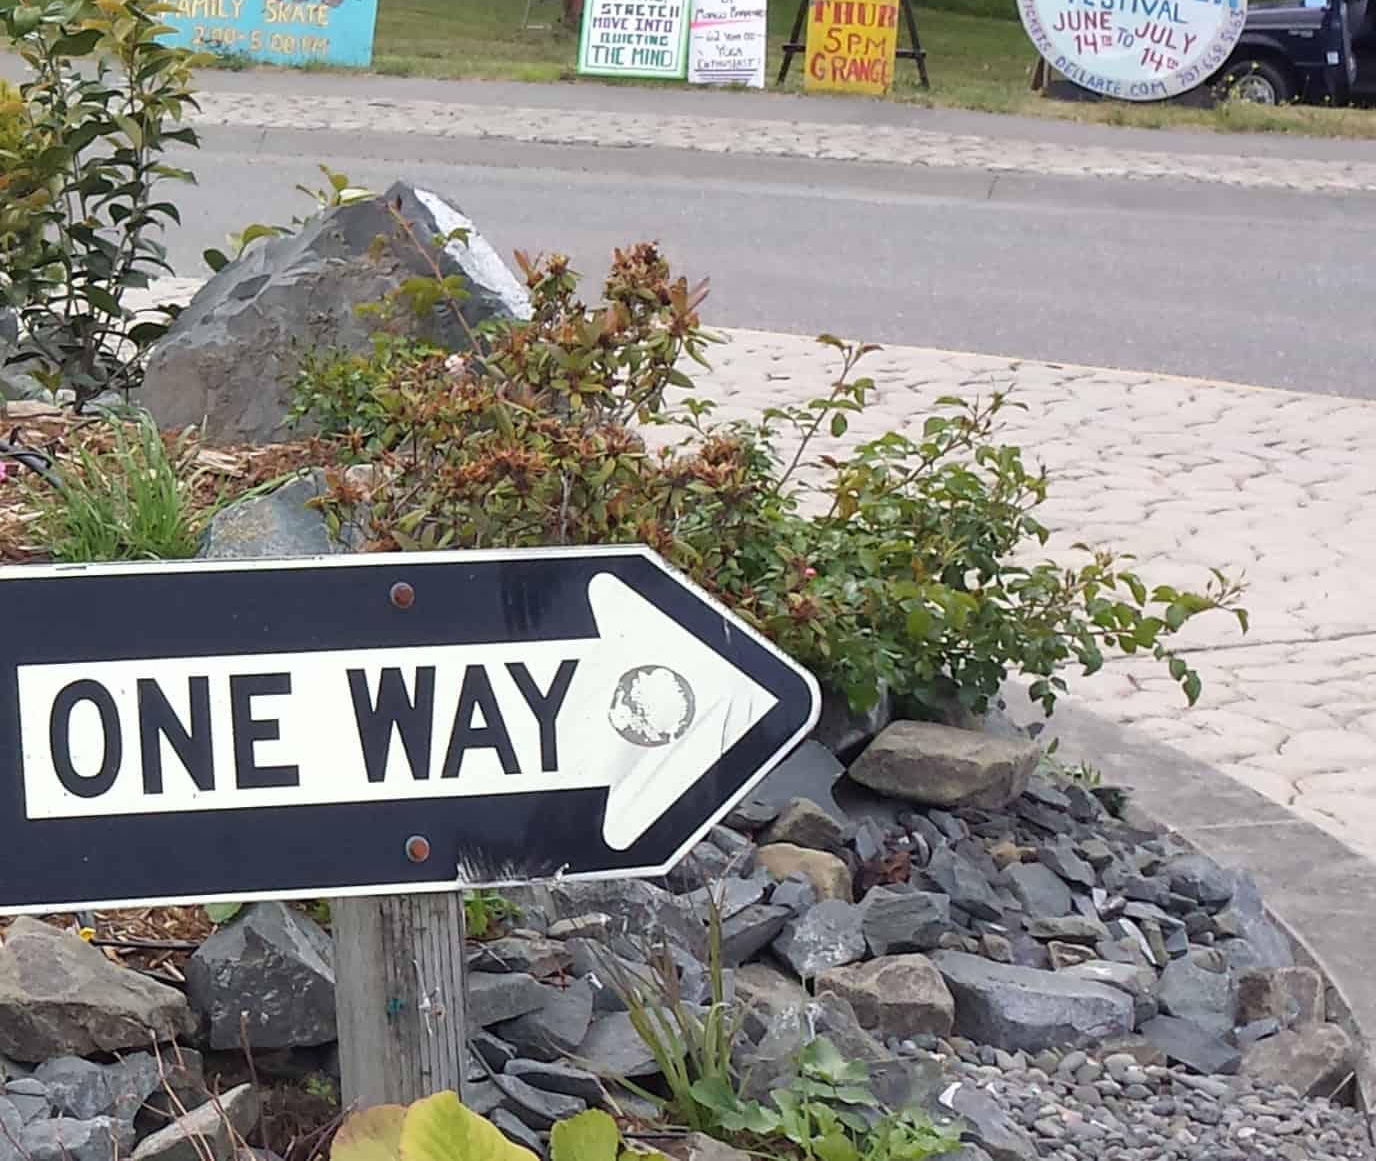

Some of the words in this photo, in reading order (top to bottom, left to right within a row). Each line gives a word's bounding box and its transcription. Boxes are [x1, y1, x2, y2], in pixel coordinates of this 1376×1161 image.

[264, 0, 329, 25] SKATE
[601, 3, 679, 18] STRETCH
[814, 0, 897, 30] THUR
[592, 17, 628, 30] MOVE
[635, 18, 673, 33] INTO
[1053, 11, 1112, 33] JUNE
[1117, 26, 1134, 48] TO
[1134, 21, 1198, 55] JULY
[600, 32, 669, 46] QUIETING
[591, 45, 625, 65] THE
[632, 48, 673, 67] MIND
[810, 52, 890, 87] GRANGE
[49, 672, 300, 800] ONE
[347, 659, 580, 783] WAY
